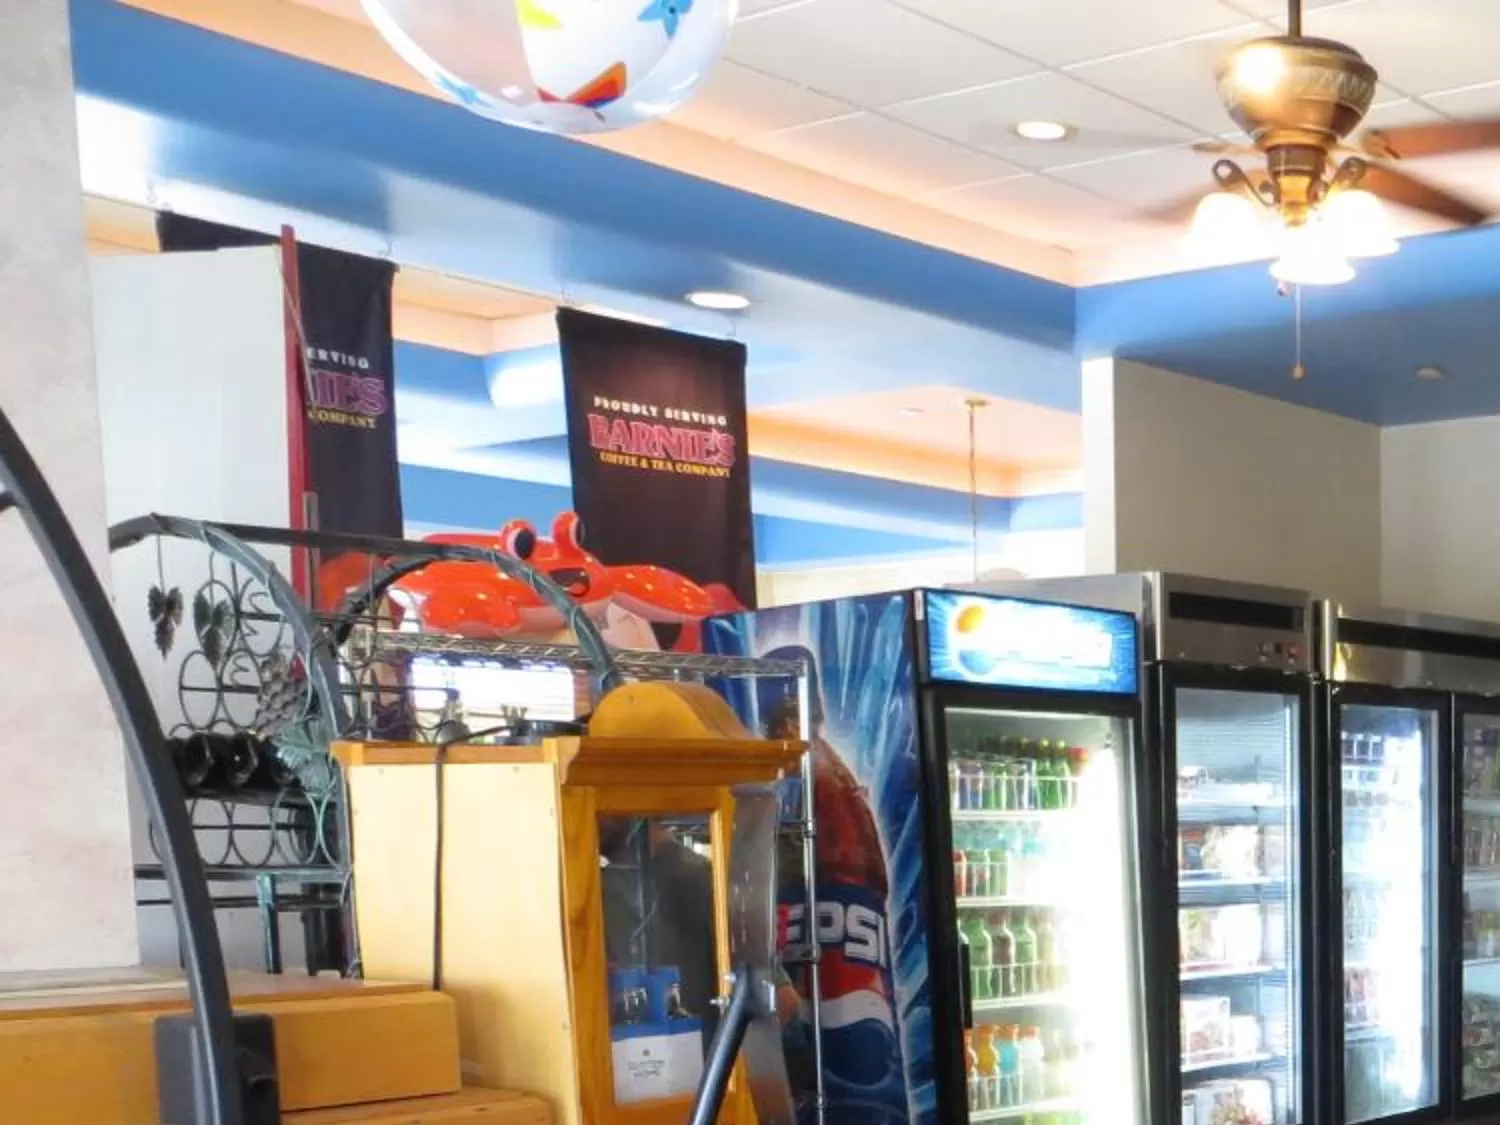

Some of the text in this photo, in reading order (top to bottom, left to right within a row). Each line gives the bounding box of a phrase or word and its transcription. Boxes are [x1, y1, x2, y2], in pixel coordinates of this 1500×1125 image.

[306, 347, 370, 369] ERVING
[594, 396, 727, 426] PROUDLY SERVING
[651, 458, 674, 472] TEA
[675, 462, 731, 478] COMPANY
